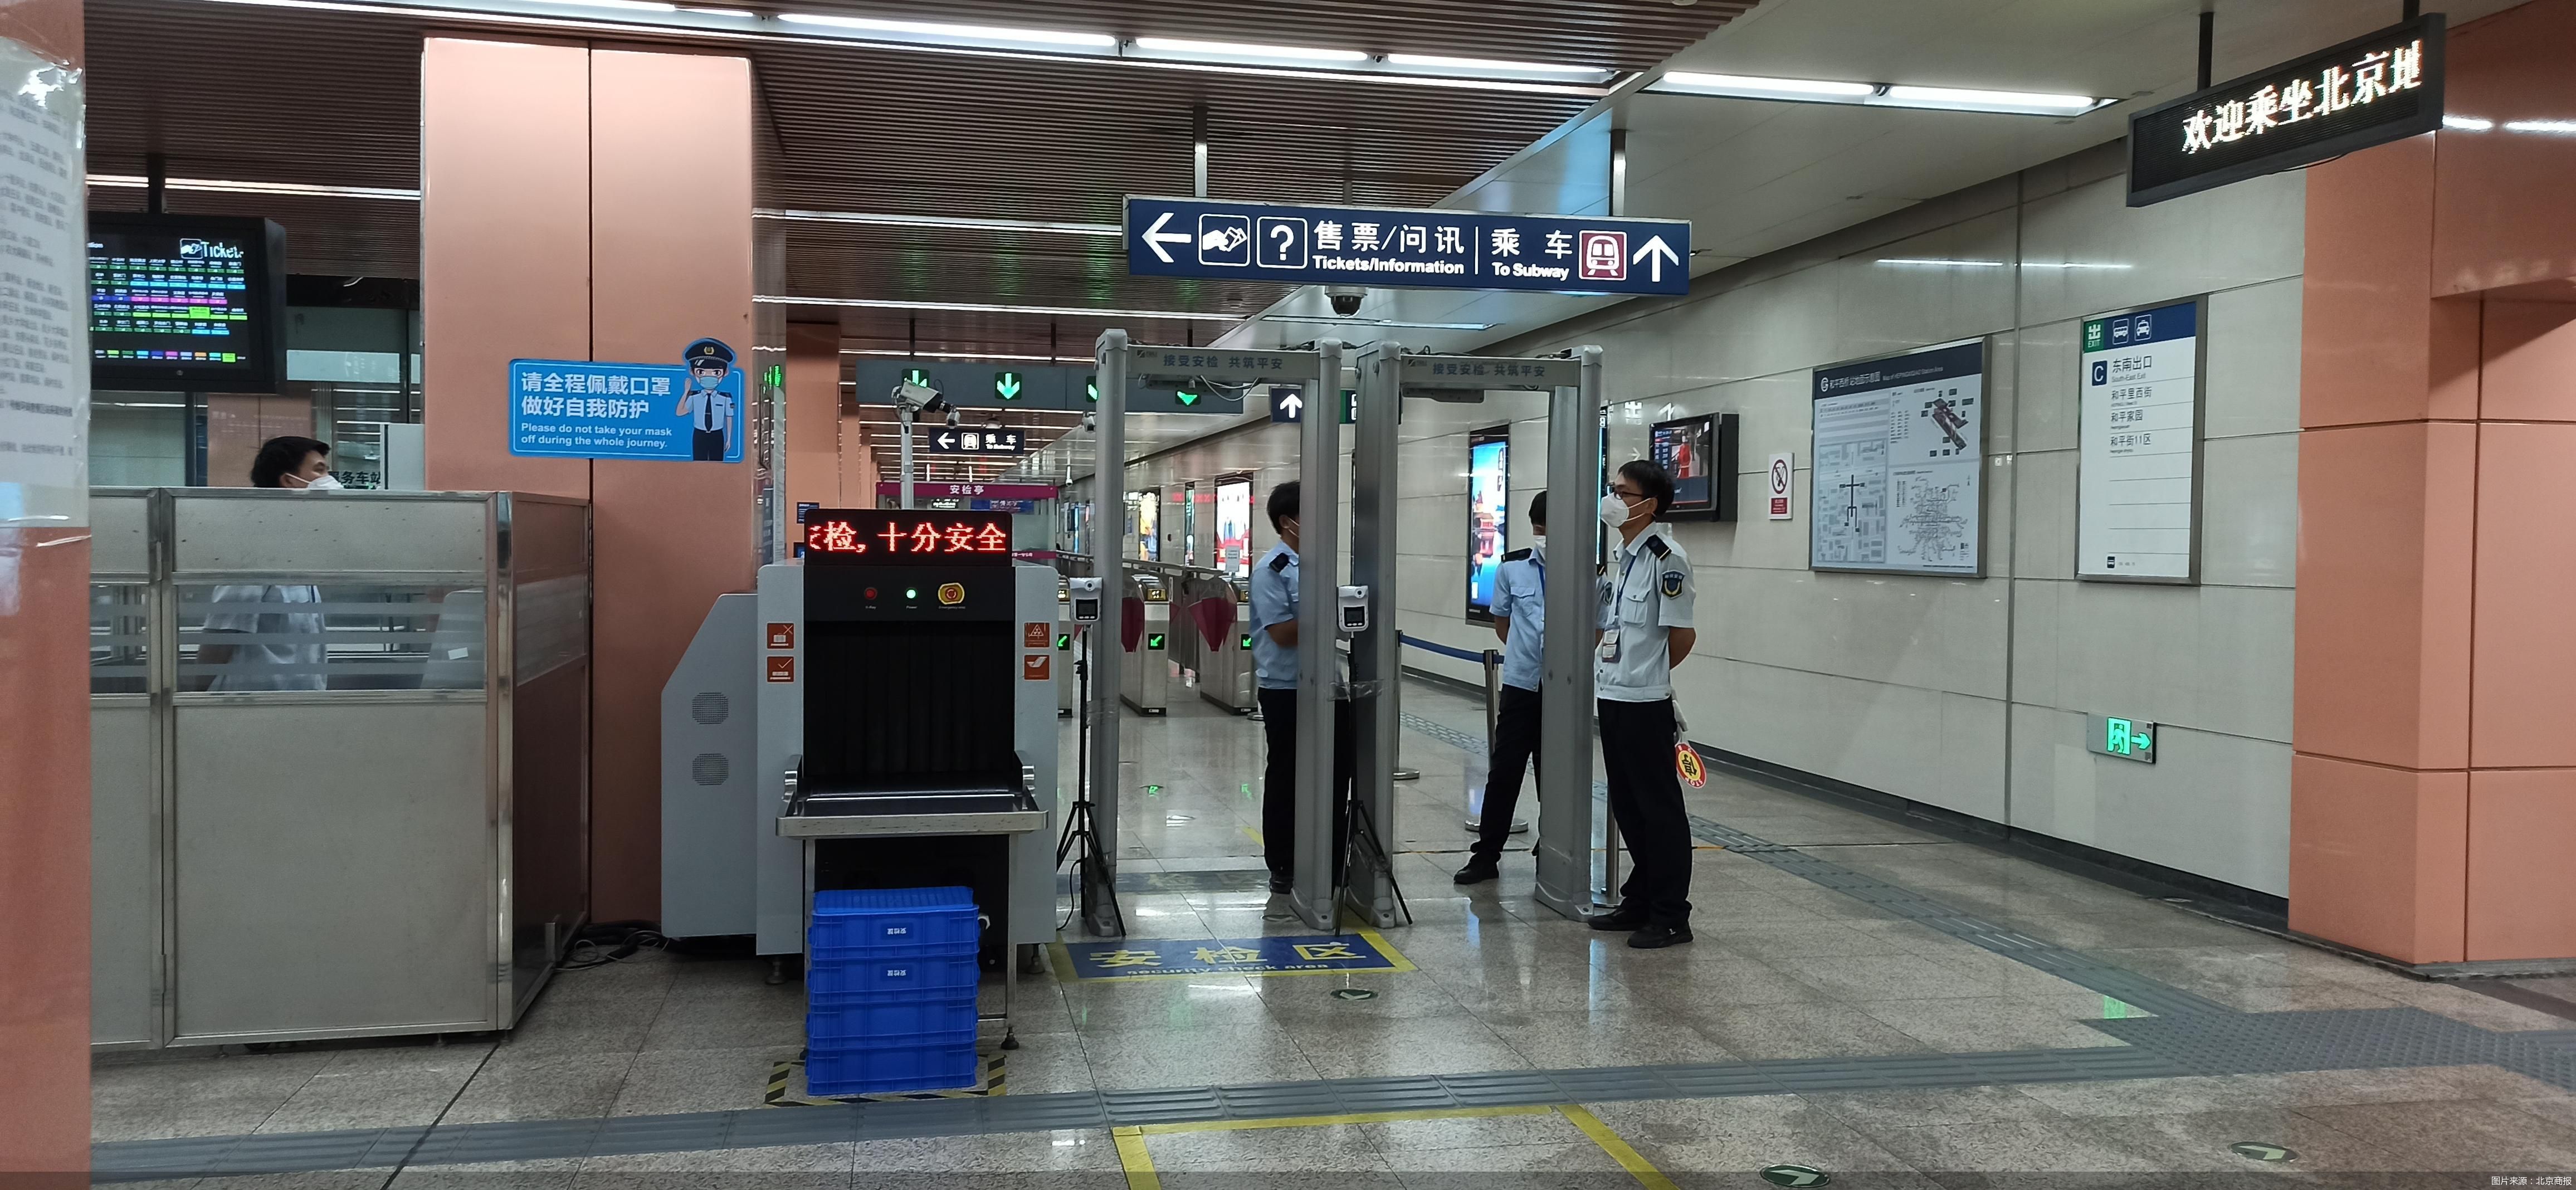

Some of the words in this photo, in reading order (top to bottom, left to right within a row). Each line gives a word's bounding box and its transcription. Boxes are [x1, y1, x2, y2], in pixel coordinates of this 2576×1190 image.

[1313, 220, 1465, 256] 售票/问讯
[1491, 227, 1573, 260] 乘车
[1312, 254, 1465, 275] Tickets/Information
[1492, 262, 1511, 277] To
[1513, 263, 1570, 281] Subway
[2088, 324, 2101, 340] 出
[1164, 354, 1218, 368] 接受安检
[1228, 357, 1283, 369] 共筑平安
[1433, 362, 1485, 376] 接受安检
[1494, 364, 1545, 377] 共筑平安
[2112, 355, 2151, 373] 东南出口
[2094, 365, 2104, 382] C
[521, 371, 671, 397] 请全程佩戴口罩
[2111, 386, 2152, 401] 和平里西街
[521, 395, 650, 420] 做好自我防护
[2111, 409, 2144, 423] 和平家园
[521, 423, 556, 433] Please
[559, 424, 572, 433] do
[575, 425, 592, 434] not
[595, 425, 616, 435] take
[619, 427, 642, 437] your
[645, 426, 672, 436] mask
[521, 435, 535, 443] off
[538, 435, 572, 447] during
[575, 436, 591, 445] the
[594, 437, 625, 447] whole
[627, 438, 668, 450] journey.
[2110, 433, 2151, 447] 和平街11区
[950, 485, 984, 495] 安检亭
[1681, 754, 1697, 776] 停
[1089, 943, 1367, 968] 安检区
[1127, 967, 1211, 976] security
[1218, 964, 1279, 973] check
